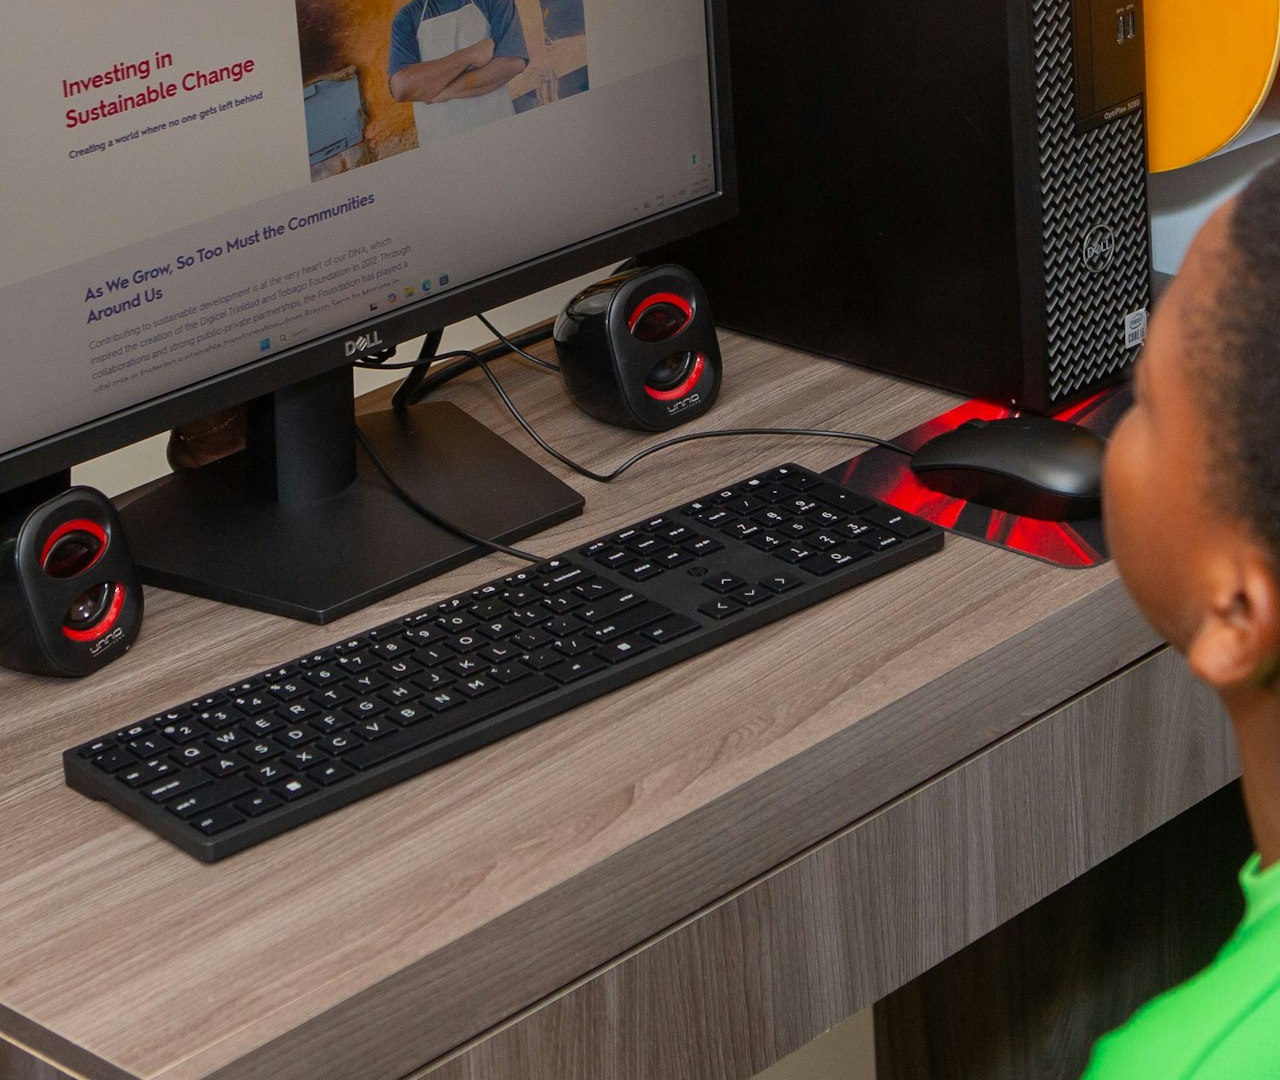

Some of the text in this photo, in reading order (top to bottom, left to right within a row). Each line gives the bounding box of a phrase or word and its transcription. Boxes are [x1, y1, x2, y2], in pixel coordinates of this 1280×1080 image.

[62, 52, 173, 98] Investing in
[66, 59, 255, 129] Sustainable Change
[68, 141, 106, 159] Creating
[115, 130, 140, 144] world
[141, 122, 167, 136] where
[168, 119, 180, 128] no
[181, 112, 198, 124] one
[199, 107, 217, 120] gets
[218, 100, 233, 112] left
[234, 91, 264, 108] behind
[84, 194, 375, 302] As We Grow, So Too Must the Communities
[1087, 240, 1111, 258] DELL
[89, 325, 141, 350] Contributing
[142, 322, 151, 332] to
[152, 306, 197, 328] sustainable
[199, 287, 250, 311] development
[252, 284, 259, 293] is
[260, 281, 268, 290] at
[269, 276, 283, 287] the
[284, 270, 301, 282] very
[301, 262, 323, 276] heart
[324, 258, 332, 267] of
[333, 255, 346, 264] our
[369, 238, 393, 251] which
[87, 288, 163, 324] Around Us
[90, 348, 123, 366] inspired
[125, 342, 138, 354] the
[140, 330, 173, 348] creation
[174, 326, 183, 335] of
[185, 322, 198, 332] the
[200, 310, 228, 327] Digicel
[228, 296, 260, 317] Trinidad
[261, 293, 277, 305] and
[278, 283, 307, 301] Tobago
[309, 265, 352, 288] Foundation
[380, 245, 411, 261] Through
[92, 352, 151, 380] collaborations
[152, 348, 168, 359] and
[169, 337, 195, 356] strong
[304, 294, 316, 304] the
[318, 278, 360, 300] Foundation
[362, 272, 375, 282] has
[376, 262, 402, 278] played
[344, 331, 383, 357] DELL
[491, 624, 502, 632] P
[419, 630, 430, 638] 9
[352, 656, 362, 664] 7
[459, 660, 475, 669] K
[392, 663, 407, 672] U
[358, 676, 371, 685] Y
[431, 674, 439, 682] J
[468, 680, 485, 690] M
[324, 690, 337, 699] T
[392, 688, 408, 697] H
[434, 694, 451, 704] N
[290, 704, 305, 714] R
[359, 701, 374, 710] G
[215, 712, 227, 720] 3
[400, 708, 416, 718] B
[255, 718, 270, 728] E
[324, 716, 336, 725] F
[180, 726, 192, 735] 2
[365, 722, 379, 732] V
[216, 732, 235, 743] W
[288, 730, 303, 739] D
[332, 737, 347, 747] C
[184, 748, 201, 757] Q
[255, 744, 268, 754] S
[296, 752, 312, 762] X
[220, 760, 234, 769] A
[260, 766, 277, 777] Z
